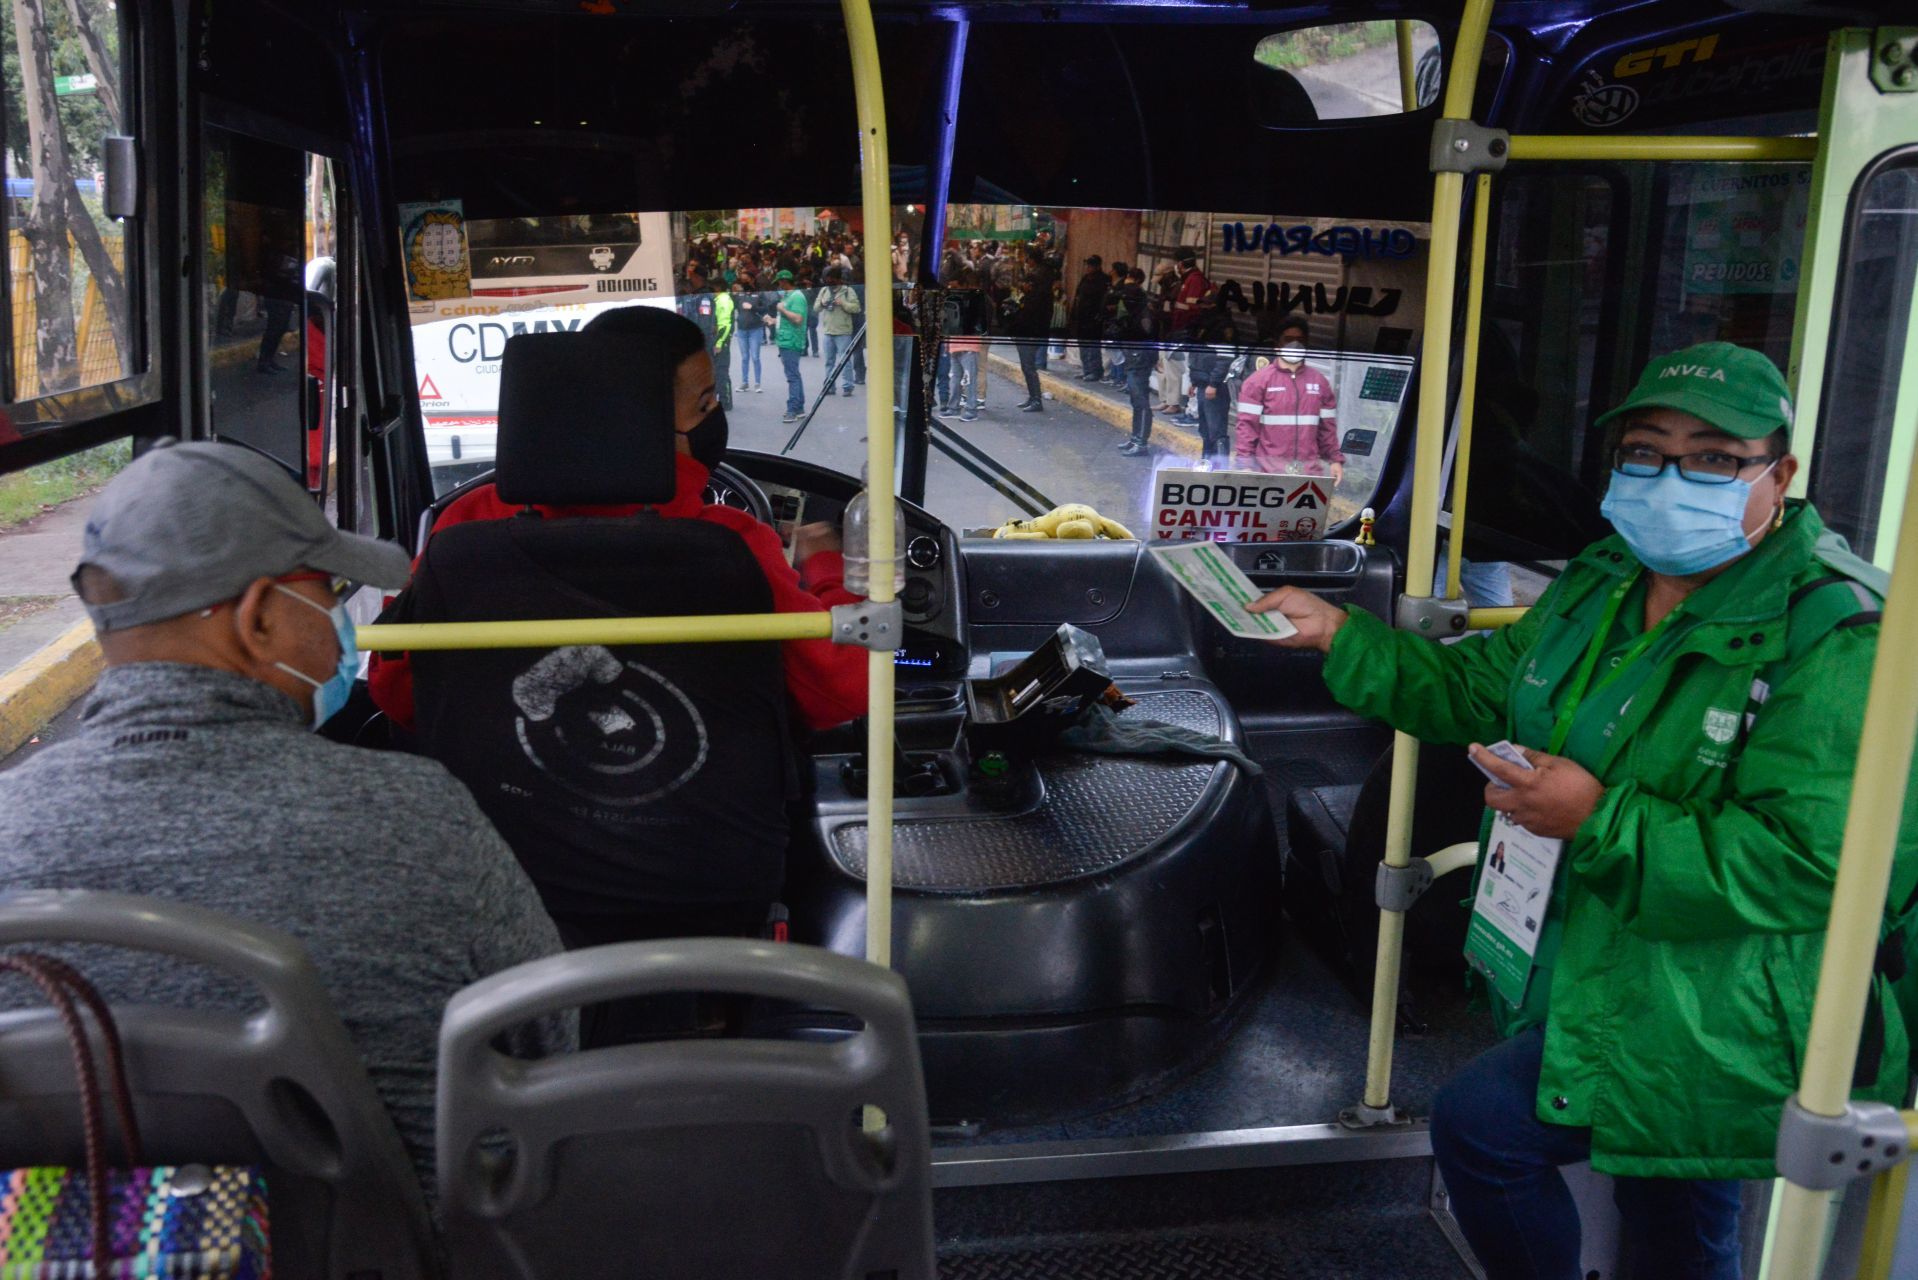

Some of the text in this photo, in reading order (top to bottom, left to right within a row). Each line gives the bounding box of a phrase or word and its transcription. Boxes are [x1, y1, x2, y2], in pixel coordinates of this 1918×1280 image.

[1614, 33, 1720, 79] GTI
[1658, 364, 1727, 383] INVEA
[1161, 483, 1318, 510] BODEGA
[1158, 508, 1268, 529] CANTIL
